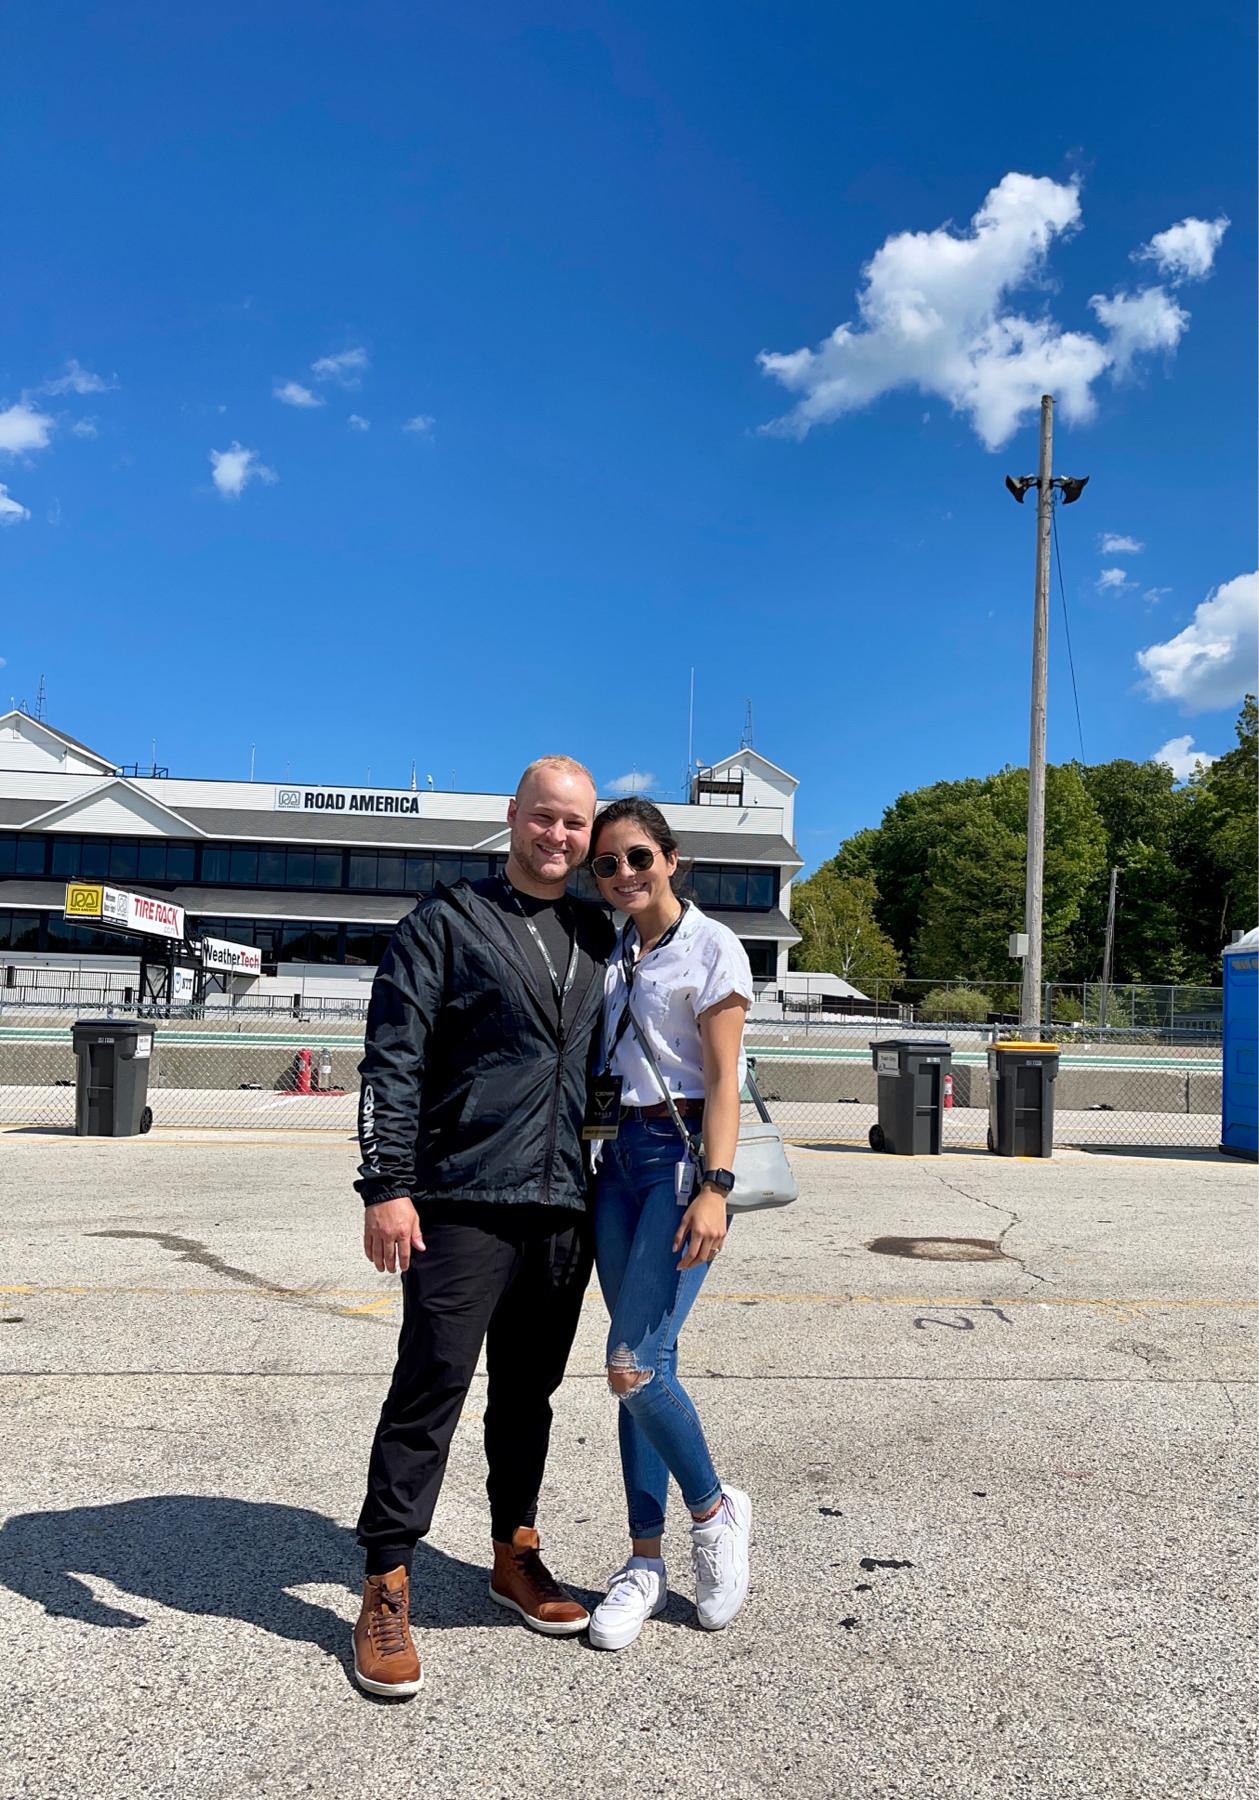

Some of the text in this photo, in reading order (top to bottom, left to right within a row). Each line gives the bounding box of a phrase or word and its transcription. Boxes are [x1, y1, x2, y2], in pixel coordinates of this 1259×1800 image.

[304, 792, 419, 814] ROAD AMERICA
[134, 898, 155, 921] TIRE
[155, 903, 179, 936] RACK
[203, 943, 260, 968] WeatherTech
